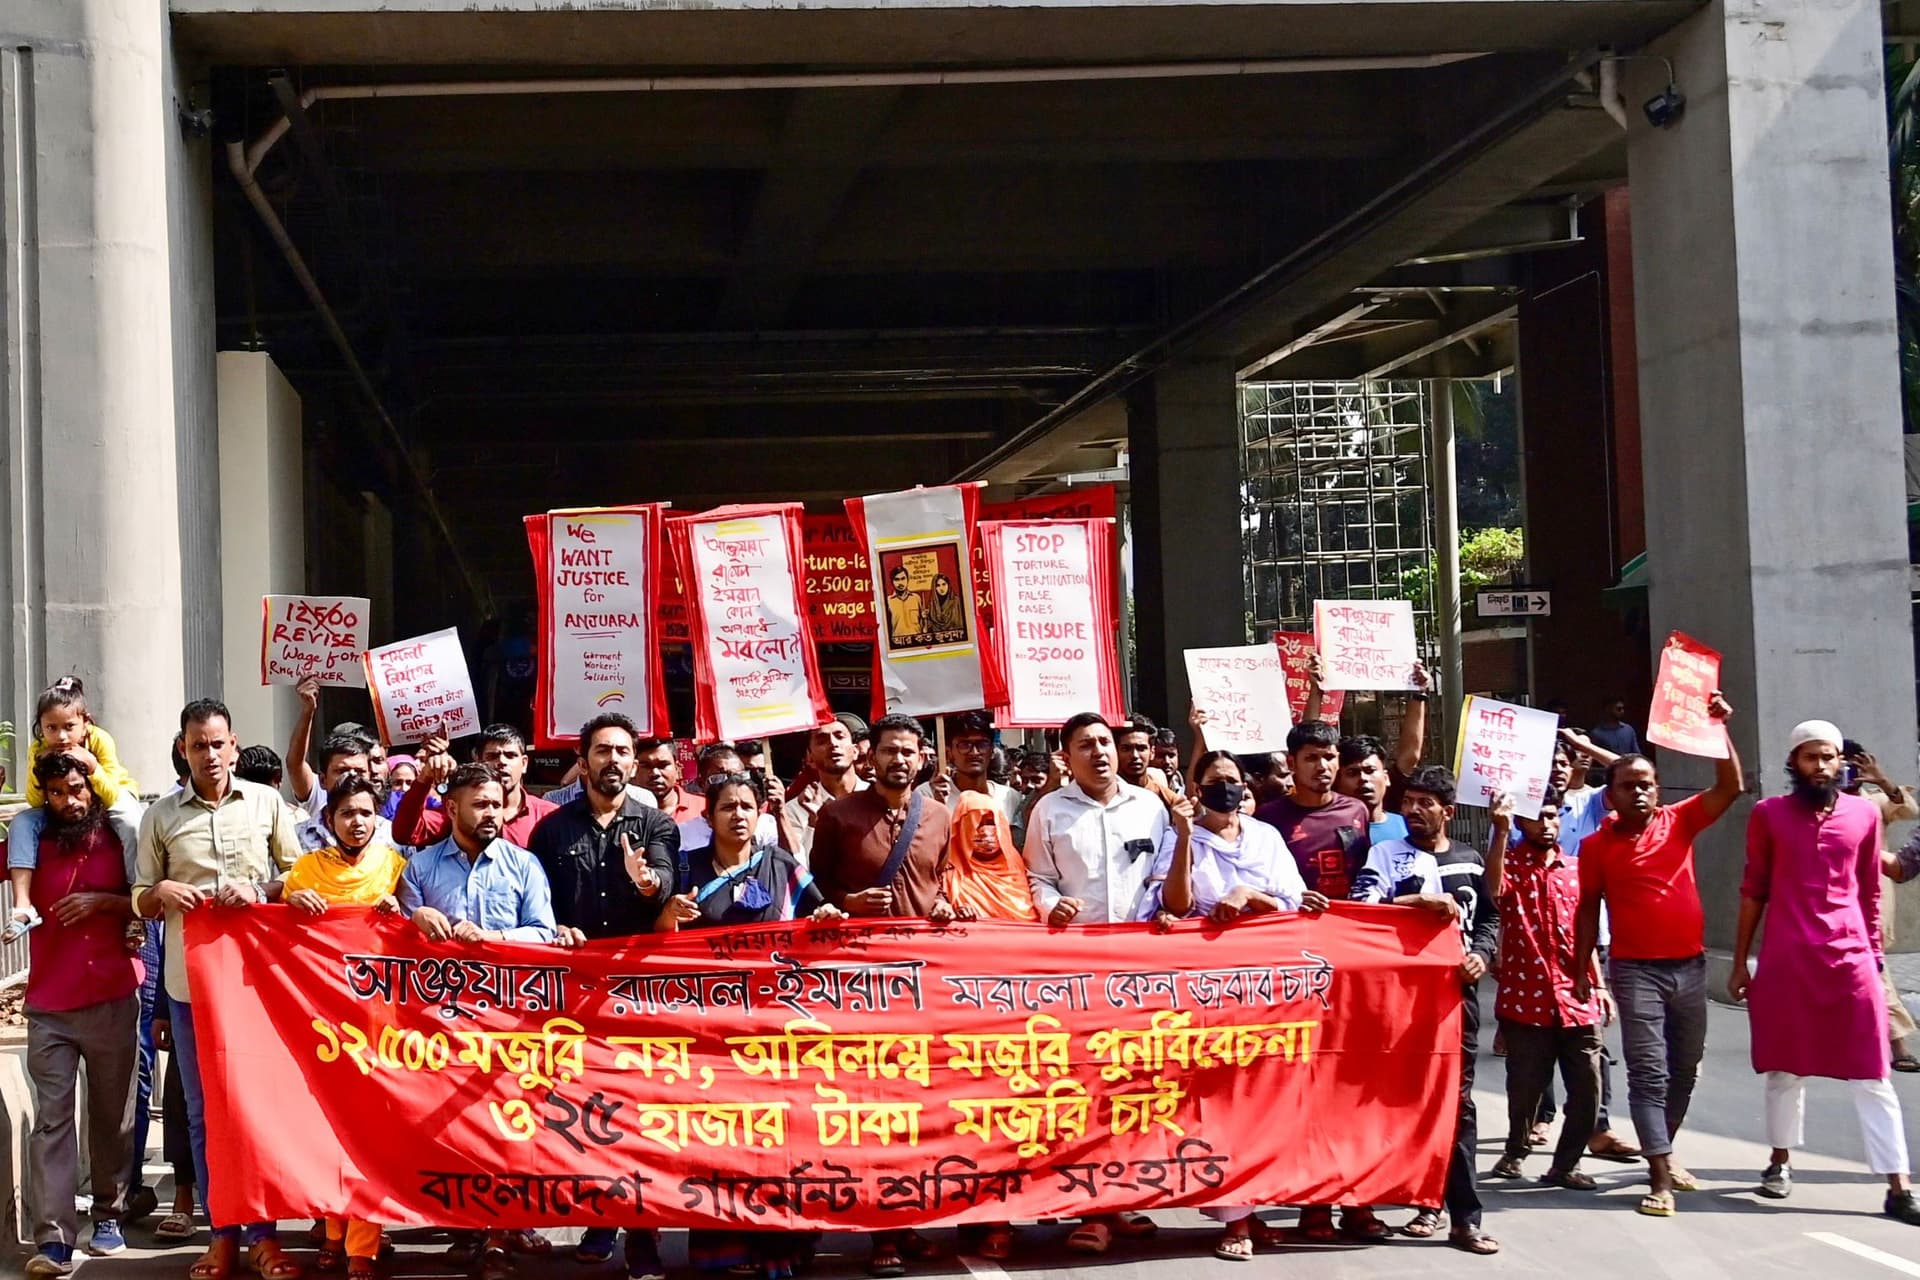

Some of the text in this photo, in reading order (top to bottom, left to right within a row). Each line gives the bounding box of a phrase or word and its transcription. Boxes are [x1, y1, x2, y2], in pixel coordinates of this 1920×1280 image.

[567, 523, 595, 543] We
[1016, 533, 1065, 553] STOP
[561, 548, 613, 567] WANT
[1012, 560, 1069, 571] TORTURE
[557, 570, 629, 587] JUSTICE
[584, 588, 605, 603] for
[1018, 590, 1052, 600] FALSE
[823, 602, 866, 619] wage
[1018, 604, 1054, 615] CASES
[564, 613, 639, 630] ANJUARA
[1016, 621, 1088, 640] ENSURE
[272, 623, 356, 648] REVISE
[283, 643, 324, 671] Wage
[1480, 707, 1518, 730] দাবি
[606, 969, 755, 1016] রাসেল
[941, 970, 1096, 1013] মরলো
[1104, 969, 1181, 1009] কেন
[1186, 966, 1274, 1009] জবাব
[1276, 950, 1335, 1010] চাই
[453, 1016, 587, 1090] মজুরি
[724, 1018, 935, 1087] অবিলম্বে
[943, 1013, 1071, 1092] মজুরি
[1085, 1009, 1320, 1081] পুনর্বিবেচনা
[637, 1101, 791, 1152] হাজার
[811, 1082, 923, 1147] টাকা
[947, 1079, 1093, 1157] মজুরি
[1110, 1075, 1188, 1137] চাই
[418, 1138, 1230, 1218] বাংলাদেশ গার্মেন্ট শ্রমিক সংহতি
